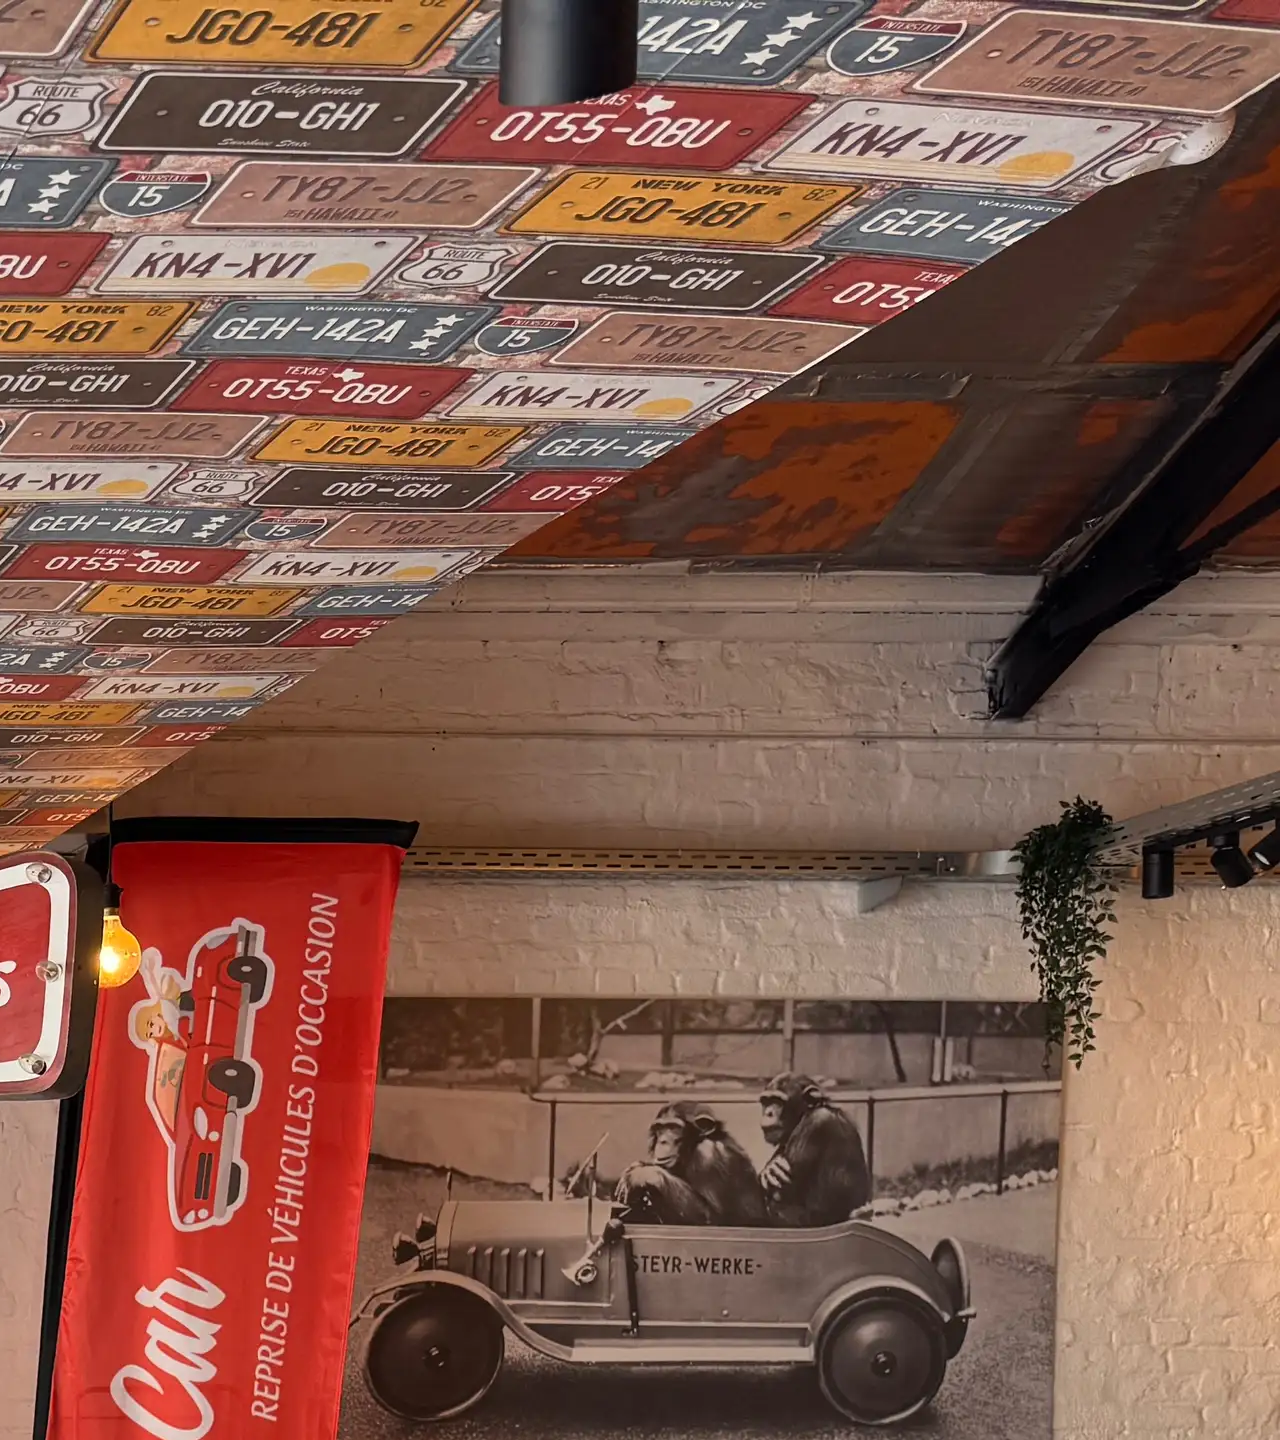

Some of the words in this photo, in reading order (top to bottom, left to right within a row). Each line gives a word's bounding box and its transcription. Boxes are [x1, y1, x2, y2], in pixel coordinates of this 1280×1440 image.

[854, 36, 915, 64] 15
[249, 81, 370, 97] California
[13, 107, 66, 126] 66
[122, 185, 173, 207] 15
[633, 251, 740, 266] California
[492, 329, 543, 348] 15
[292, 892, 339, 1077] D'OCCASION
[267, 1084, 316, 1245] VÉHICULES
[266, 1252, 296, 1294] DE
[251, 1298, 290, 1422] REPRISE
